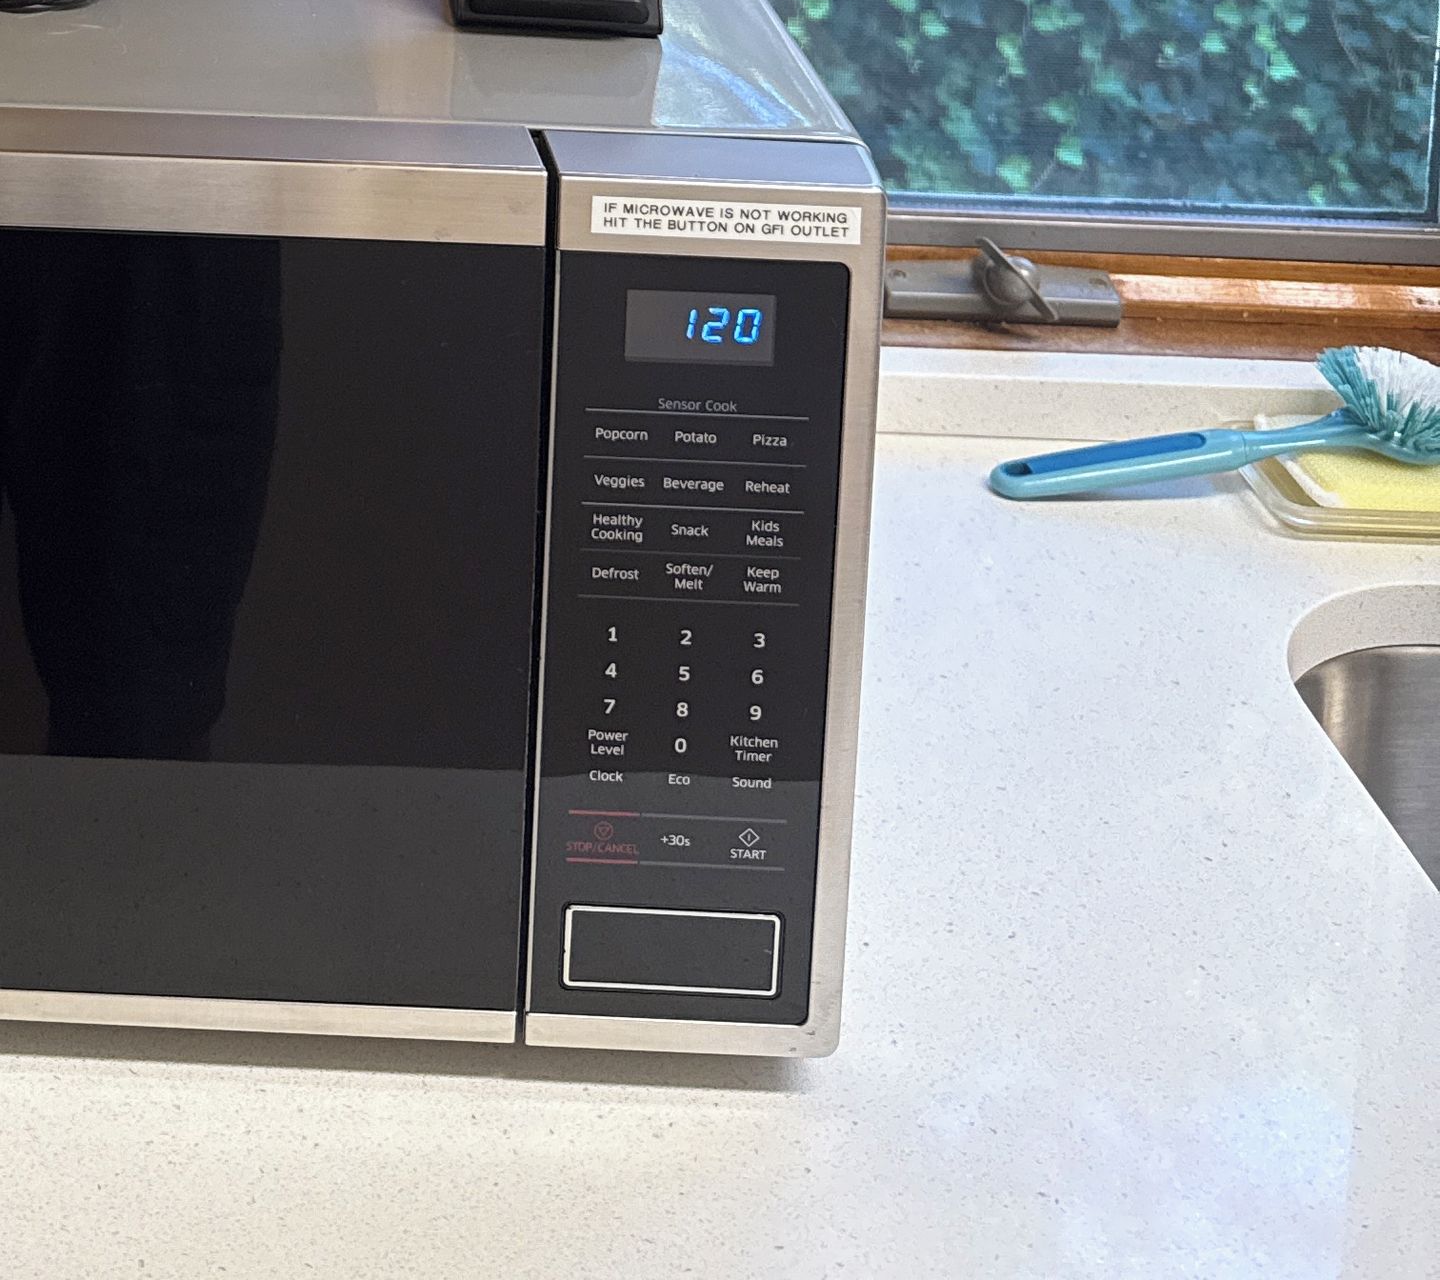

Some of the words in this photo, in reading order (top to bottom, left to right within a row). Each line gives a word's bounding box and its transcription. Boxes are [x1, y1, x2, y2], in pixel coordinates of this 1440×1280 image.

[604, 203, 617, 213] IF
[623, 204, 714, 218] MICROWAVE
[720, 208, 734, 218] IS
[740, 209, 771, 220] NOT
[778, 210, 847, 223] WORKING
[603, 217, 628, 228] HIT
[633, 218, 662, 229] THE
[668, 219, 728, 233] BUTTON
[734, 223, 755, 233] ON
[761, 224, 784, 235] GFI
[790, 225, 849, 237] OUTLET
[658, 398, 701, 411] Sensor
[705, 400, 737, 412] Cook
[595, 428, 648, 442] Popcorn
[675, 431, 717, 444] Potato
[753, 434, 787, 447] Pizza
[594, 474, 645, 489] Veggies
[663, 477, 724, 492] Beverage
[746, 481, 790, 494] Reheat
[593, 513, 643, 528] Healthy
[751, 521, 780, 533] Kids
[591, 528, 643, 542] Cooking
[671, 524, 709, 537] Snack
[746, 535, 784, 547] Meals
[592, 567, 640, 580] Defrost
[665, 563, 714, 576] Soften/
[747, 567, 780, 580] Keep
[674, 578, 704, 590] Melt
[744, 582, 782, 593] Warm
[608, 627, 618, 642] 1
[680, 630, 692, 645] 2
[754, 633, 765, 648] 3
[605, 663, 617, 678] 4
[679, 666, 690, 681] 5
[751, 669, 764, 684] 6
[604, 699, 616, 714] 7
[676, 702, 688, 717] 8
[750, 706, 762, 720] 9
[588, 730, 629, 741] Power
[590, 743, 624, 755] Level
[674, 738, 687, 753] 0
[730, 736, 778, 749] Kitchen
[735, 750, 772, 762] Timer
[589, 770, 623, 782] Clock
[668, 774, 690, 785] Eco
[732, 776, 772, 789] Sound
[660, 834, 691, 846] +30s
[566, 841, 640, 855] STOP/CANCEL
[730, 848, 767, 860] START
